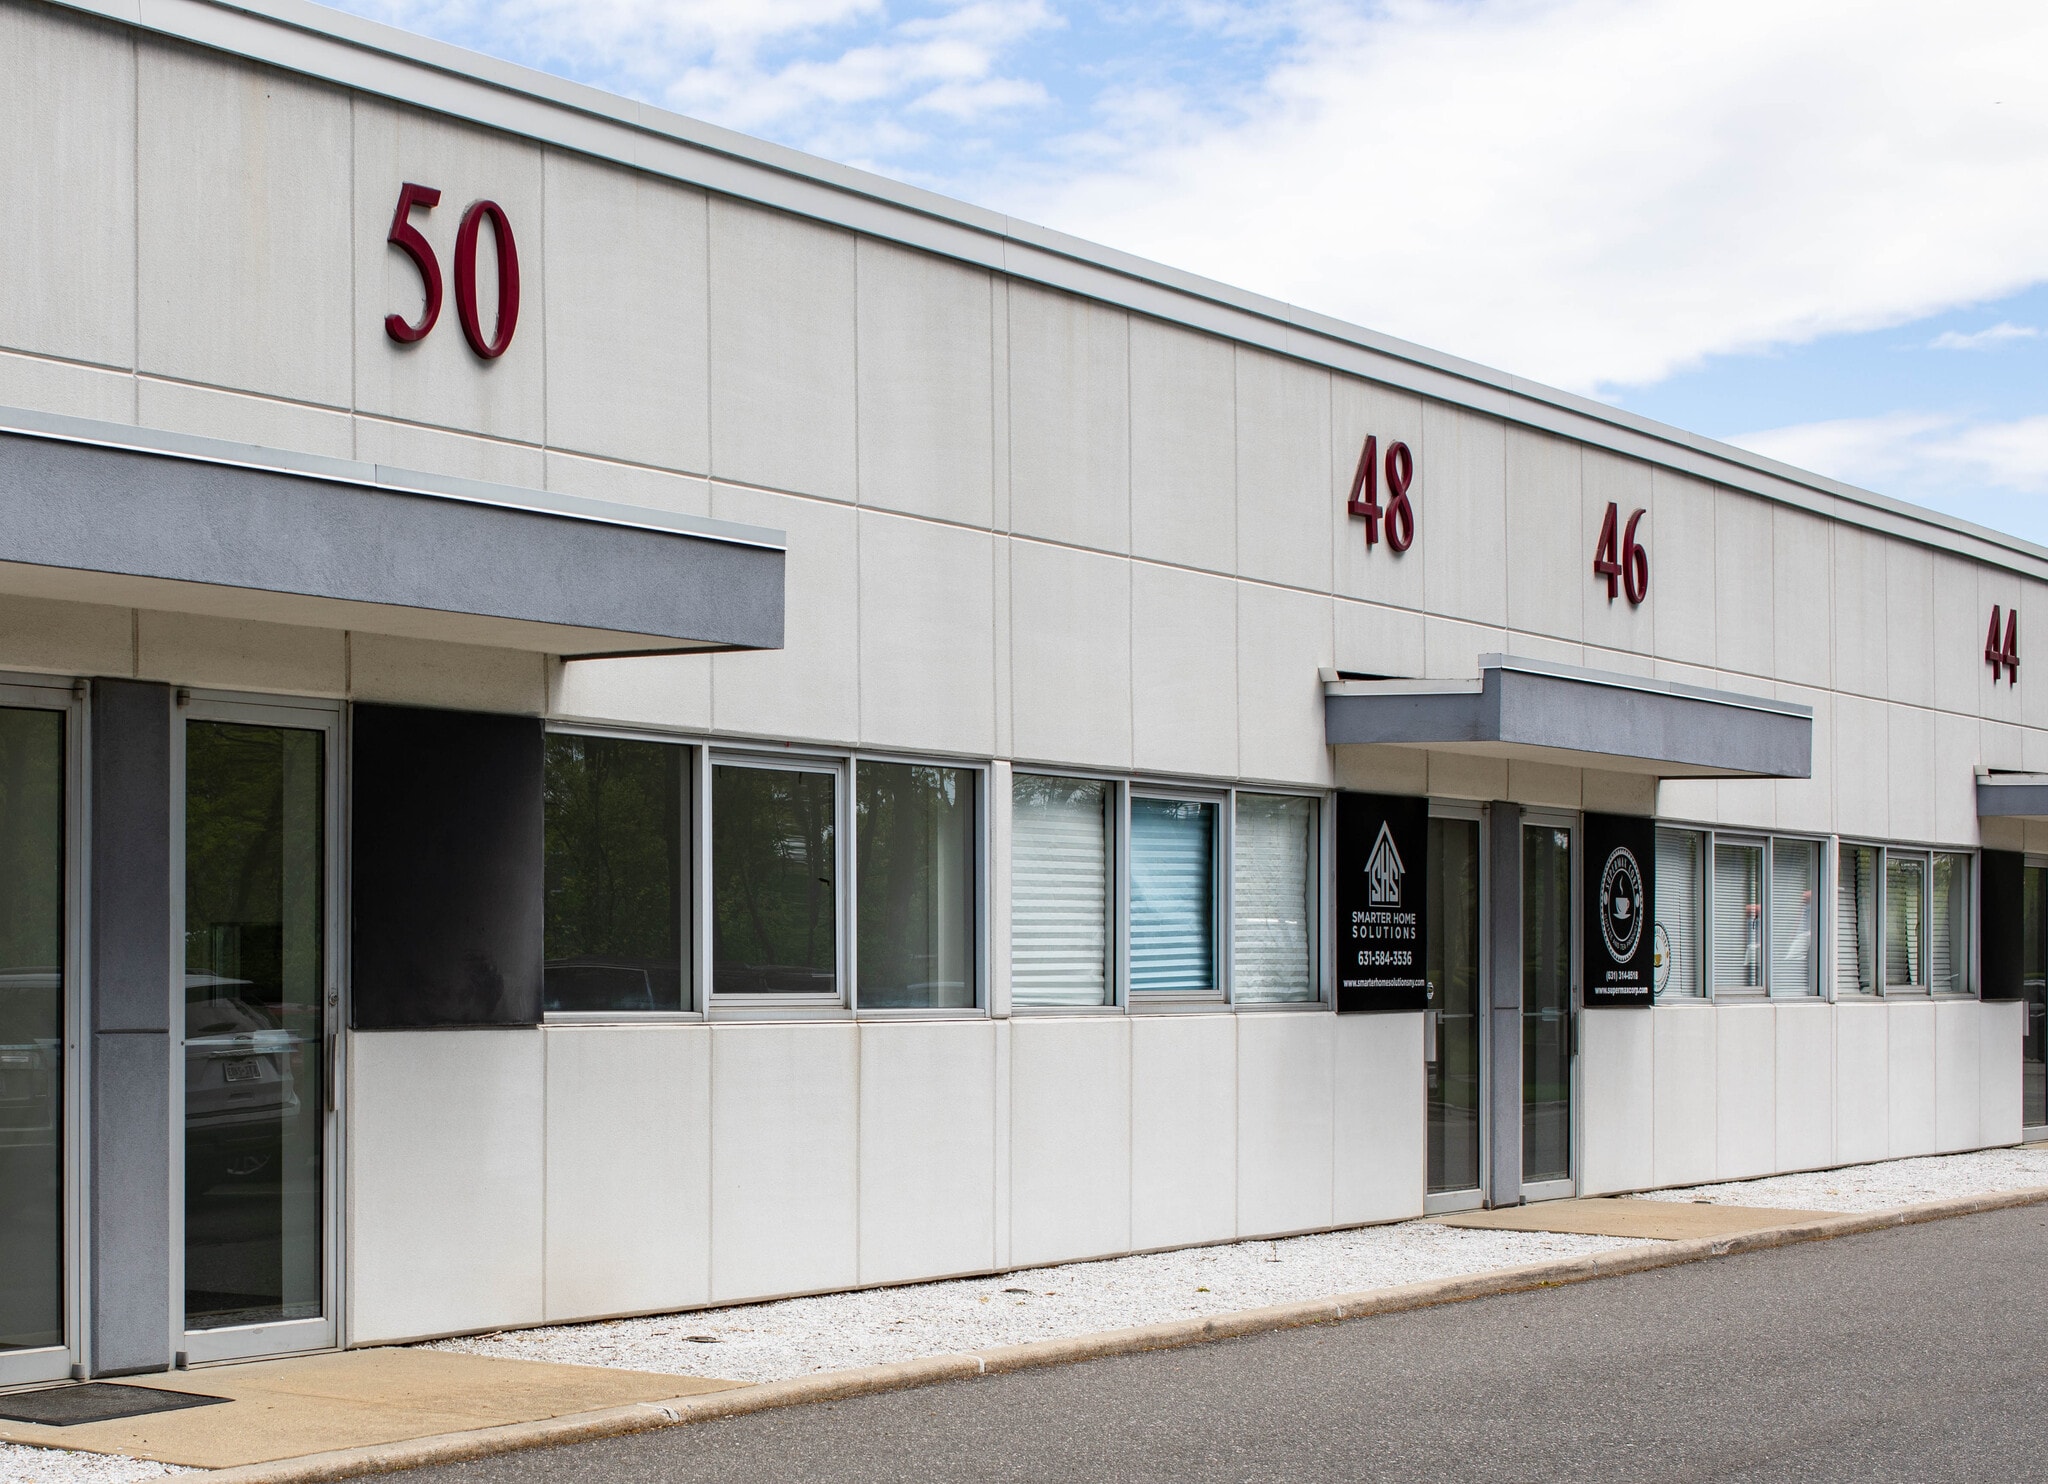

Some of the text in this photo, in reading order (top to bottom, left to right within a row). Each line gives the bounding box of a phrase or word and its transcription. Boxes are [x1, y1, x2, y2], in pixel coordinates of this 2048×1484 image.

[384, 181, 520, 359] 50
[1348, 434, 1414, 552] 48
[1594, 501, 1648, 604] 46
[1985, 604, 2020, 684] 44
[1371, 841, 1399, 902] SHS
[1352, 911, 1416, 925] SMARTER HOME
[1352, 925, 1416, 940] SOLUTIONS
[1343, 977, 1425, 989] www.smarterhomesolutionsny.com
[1358, 950, 1412, 966] 631-584-3536
